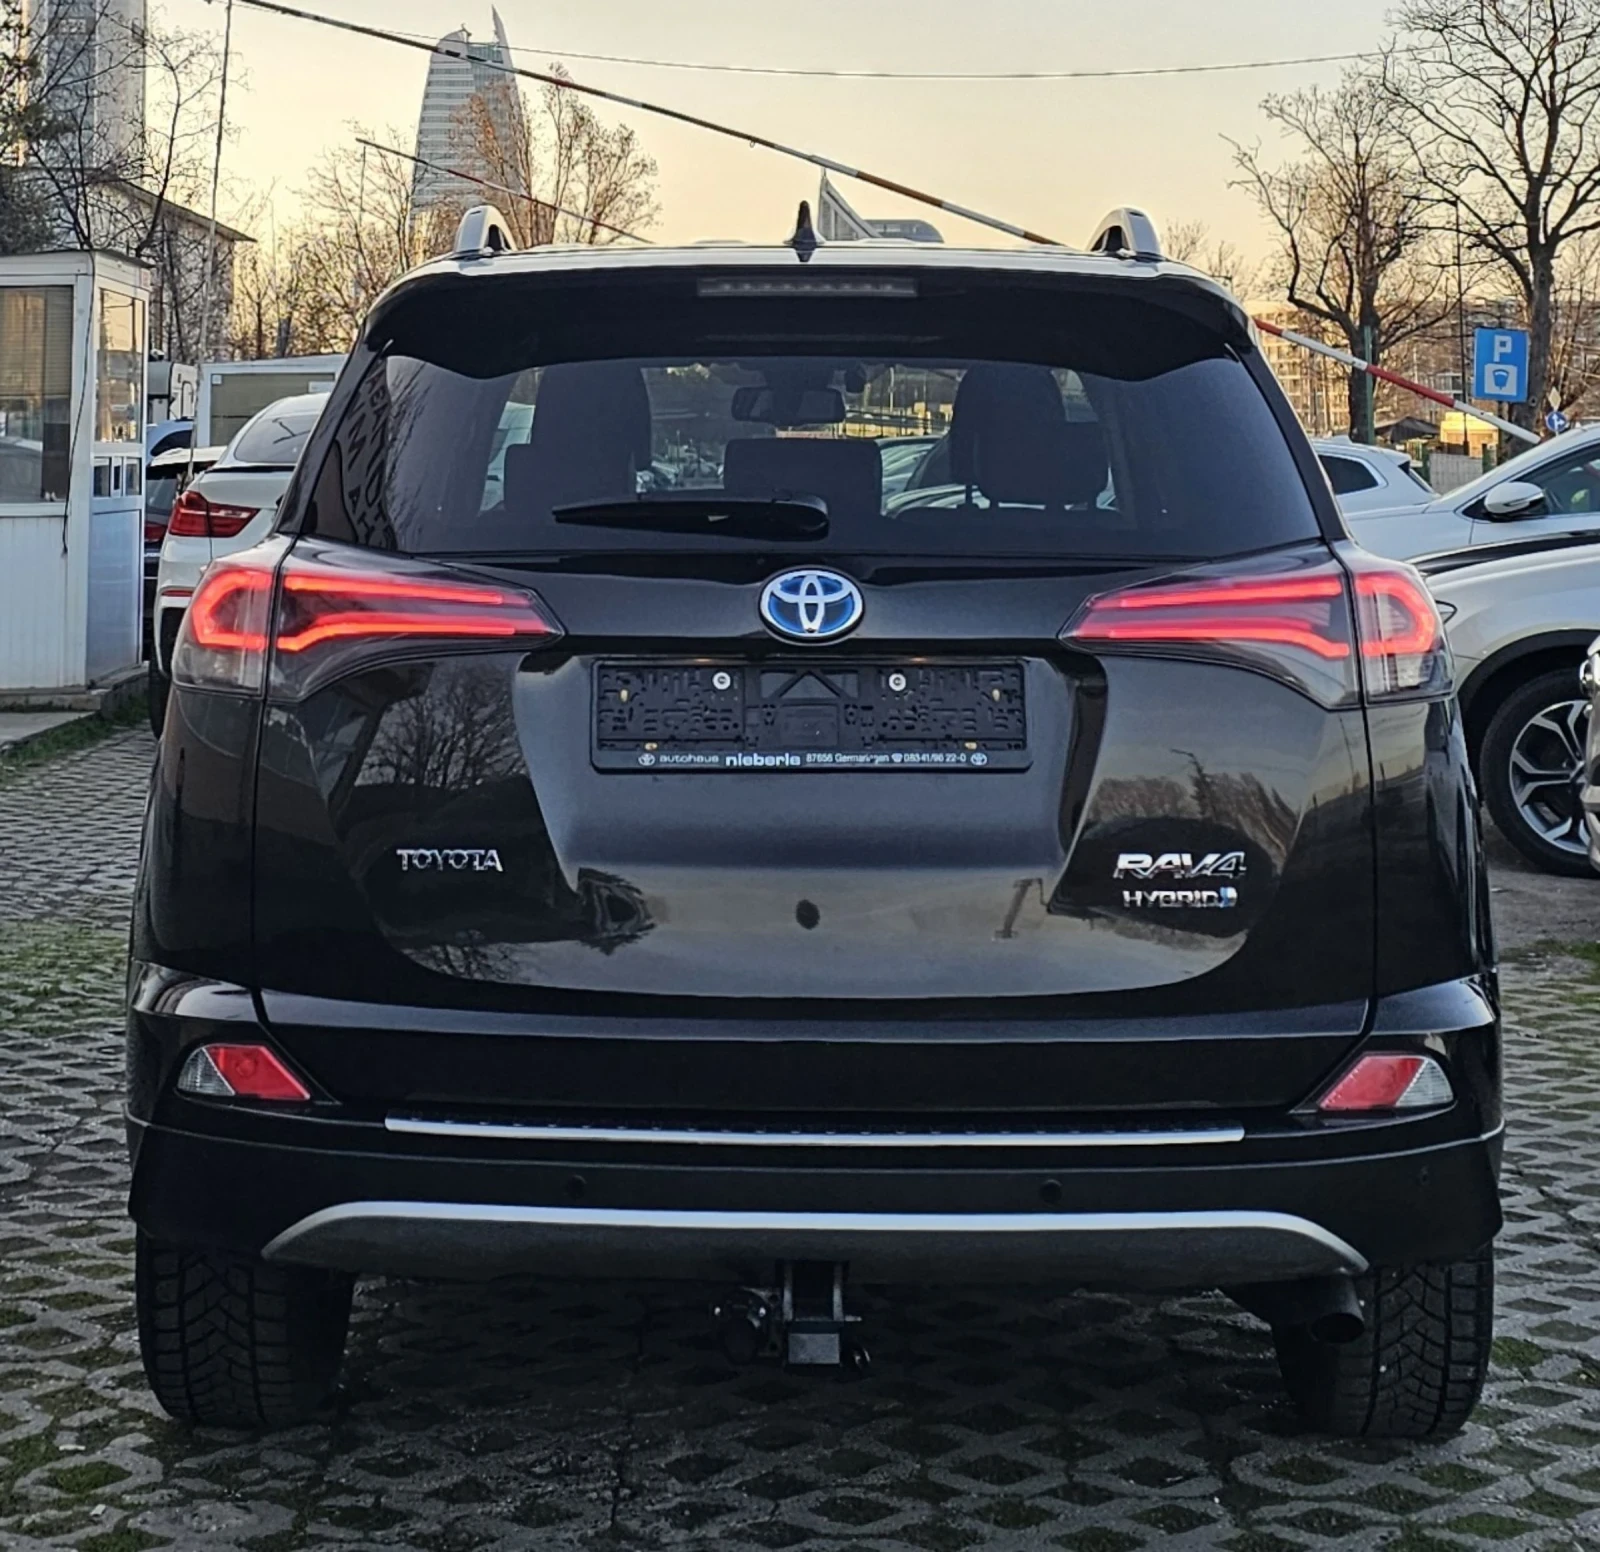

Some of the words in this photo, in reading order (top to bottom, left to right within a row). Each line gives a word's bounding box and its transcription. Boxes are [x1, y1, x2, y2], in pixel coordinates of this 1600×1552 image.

[1493, 334, 1512, 362] P
[659, 753, 719, 764] autohaus
[725, 752, 801, 767] nieberle
[396, 849, 503, 872] TOYOTA
[1112, 851, 1247, 879] RAV4
[1122, 889, 1221, 908] HYBRID
